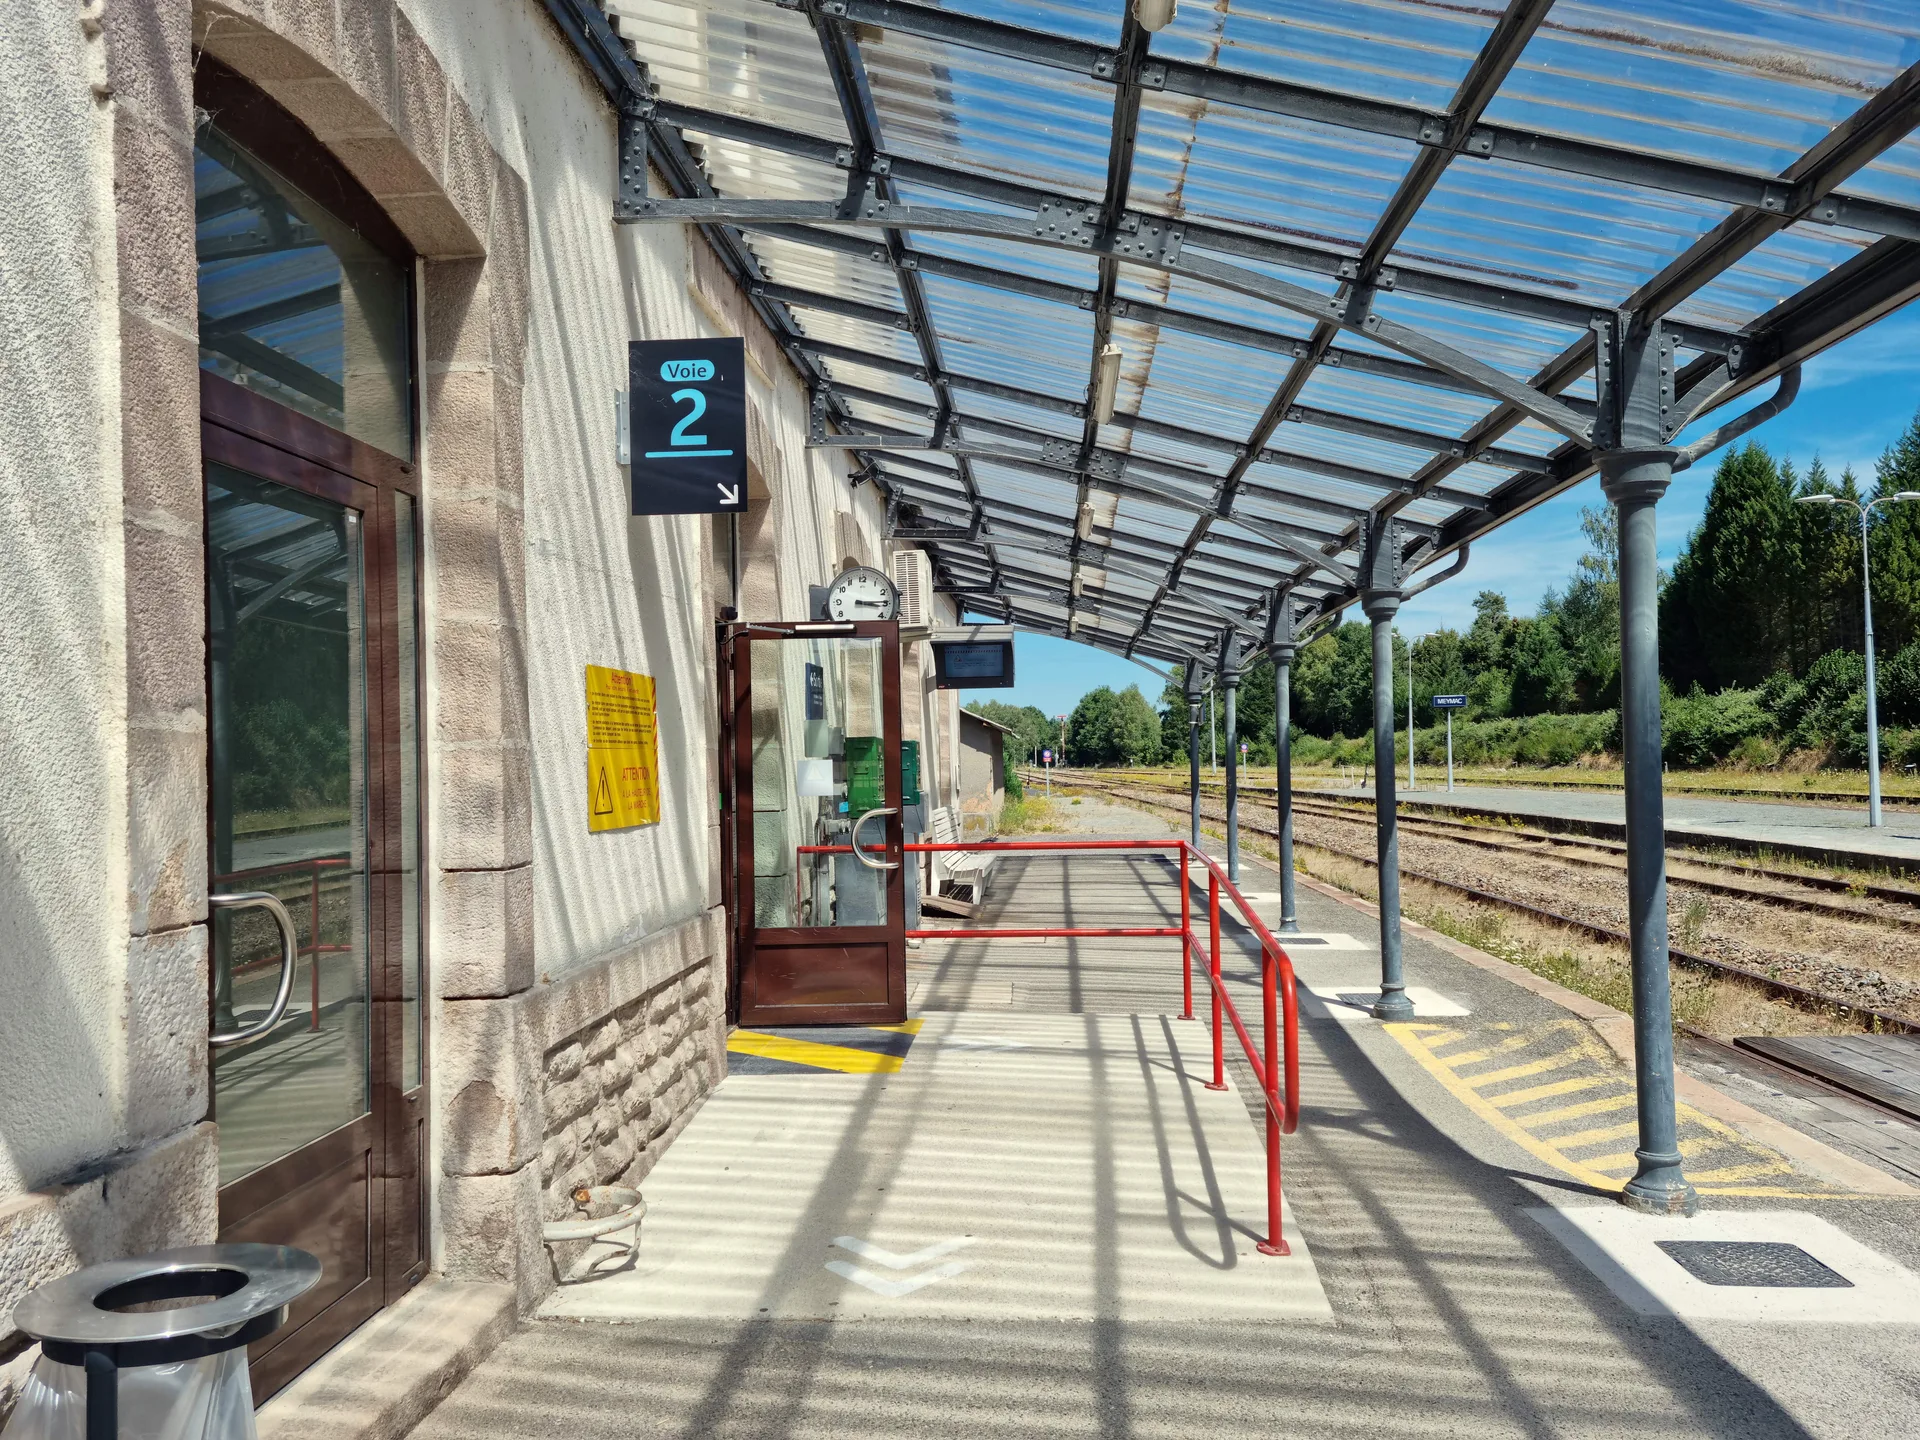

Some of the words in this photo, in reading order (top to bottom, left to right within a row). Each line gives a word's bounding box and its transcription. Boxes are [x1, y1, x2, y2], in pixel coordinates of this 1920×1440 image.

[667, 363, 707, 379] Voie
[670, 388, 708, 446] 2
[622, 767, 650, 781] ATTENTION
